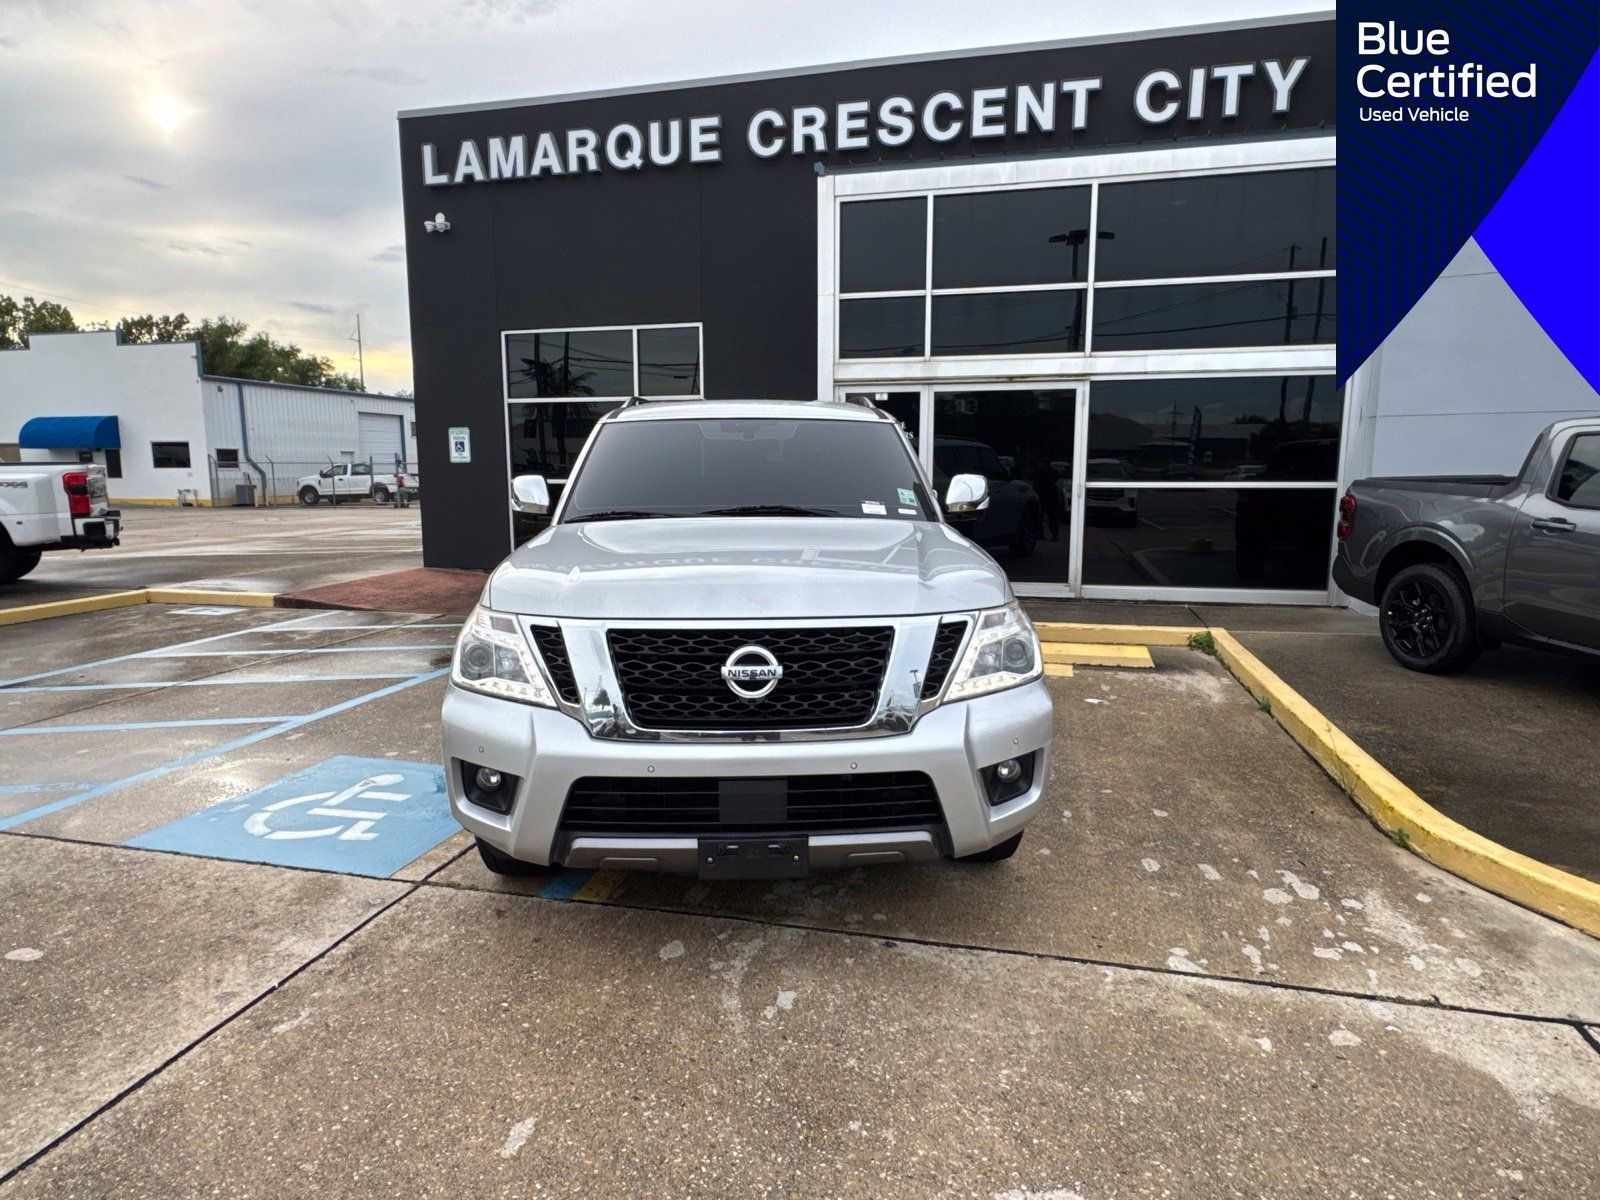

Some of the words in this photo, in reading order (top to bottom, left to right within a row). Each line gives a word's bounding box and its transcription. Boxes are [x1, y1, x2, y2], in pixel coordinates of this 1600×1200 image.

[422, 115, 722, 186] LAMARQUE
[747, 78, 1102, 159] CRESCENT
[1134, 56, 1312, 125] CITY
[728, 669, 776, 678] NISSAN
